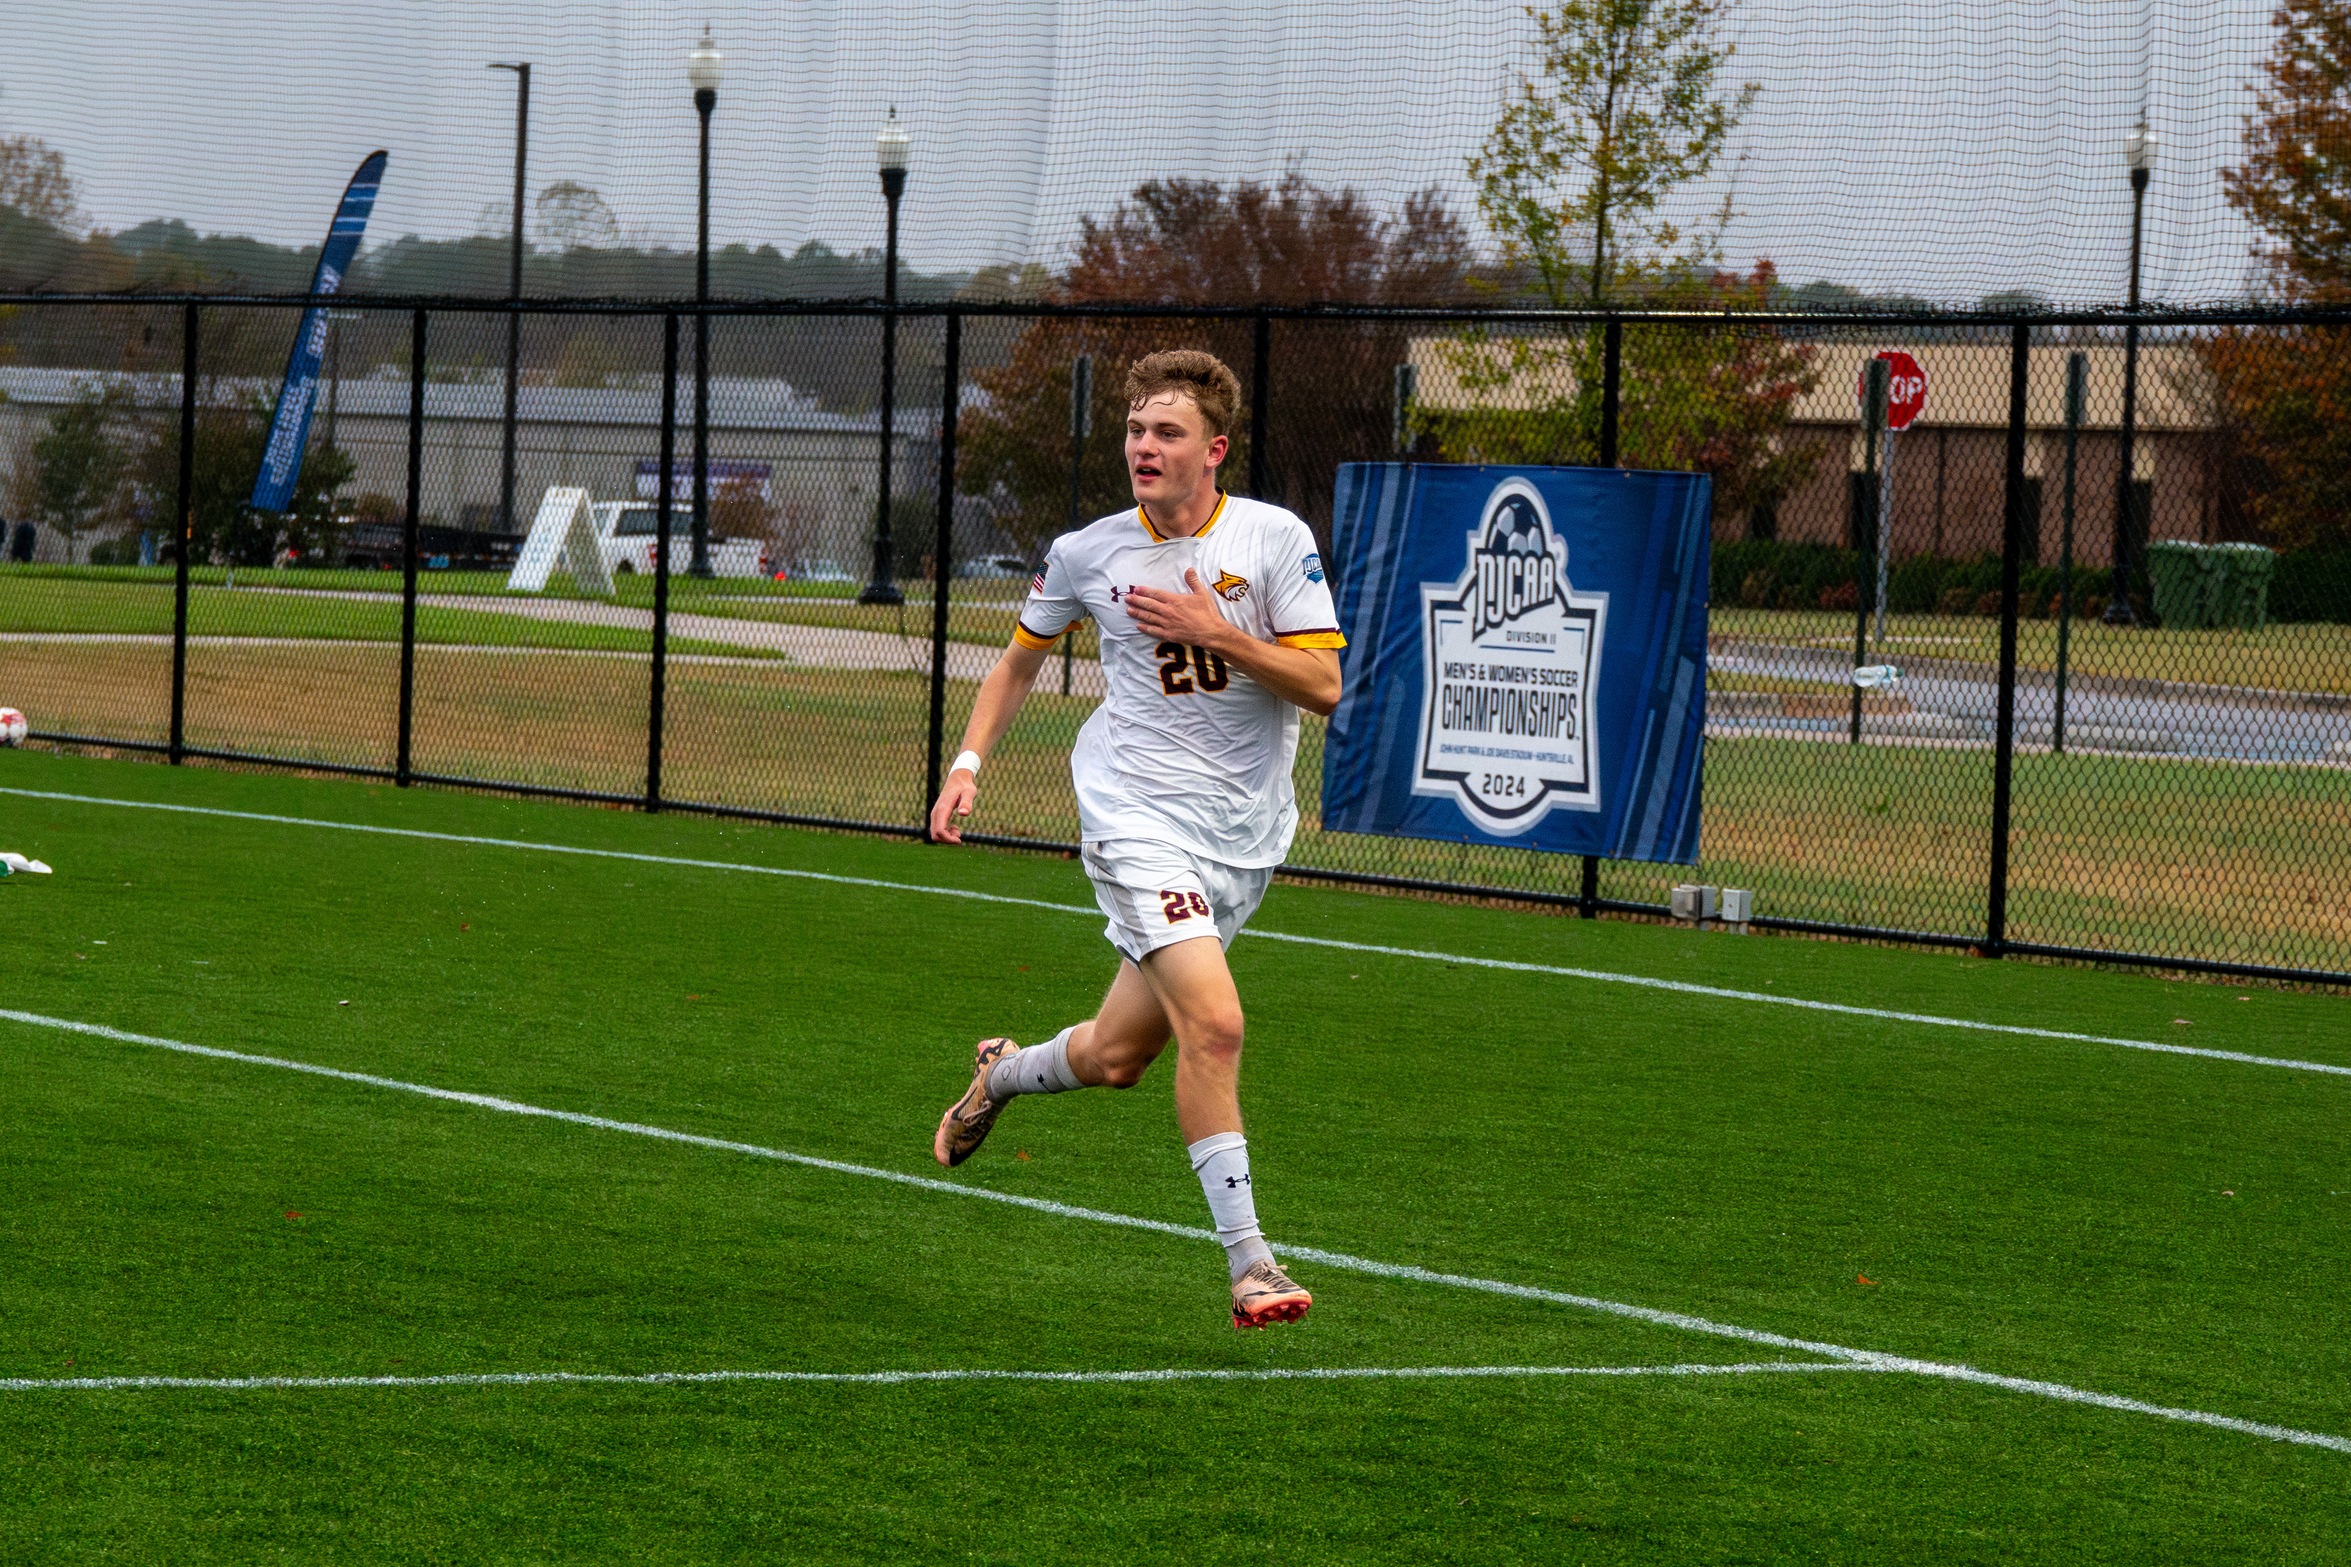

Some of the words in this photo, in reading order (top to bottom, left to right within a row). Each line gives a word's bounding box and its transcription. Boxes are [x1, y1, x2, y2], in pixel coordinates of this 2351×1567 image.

[1473, 552, 1555, 636] NJCAA
[1506, 630, 1547, 644] DIVISION
[1549, 633, 1557, 645] II
[1155, 641, 1229, 696] 20
[1444, 662, 1475, 680] MEN'S
[1479, 664, 1485, 680] &
[1489, 665, 1537, 685] WOMEN'S
[1540, 668, 1578, 688] SOCCER
[1442, 684, 1577, 740] CHAMPIONSHIPS
[1482, 773, 1525, 798] 2024
[1160, 889, 1209, 925] 20
